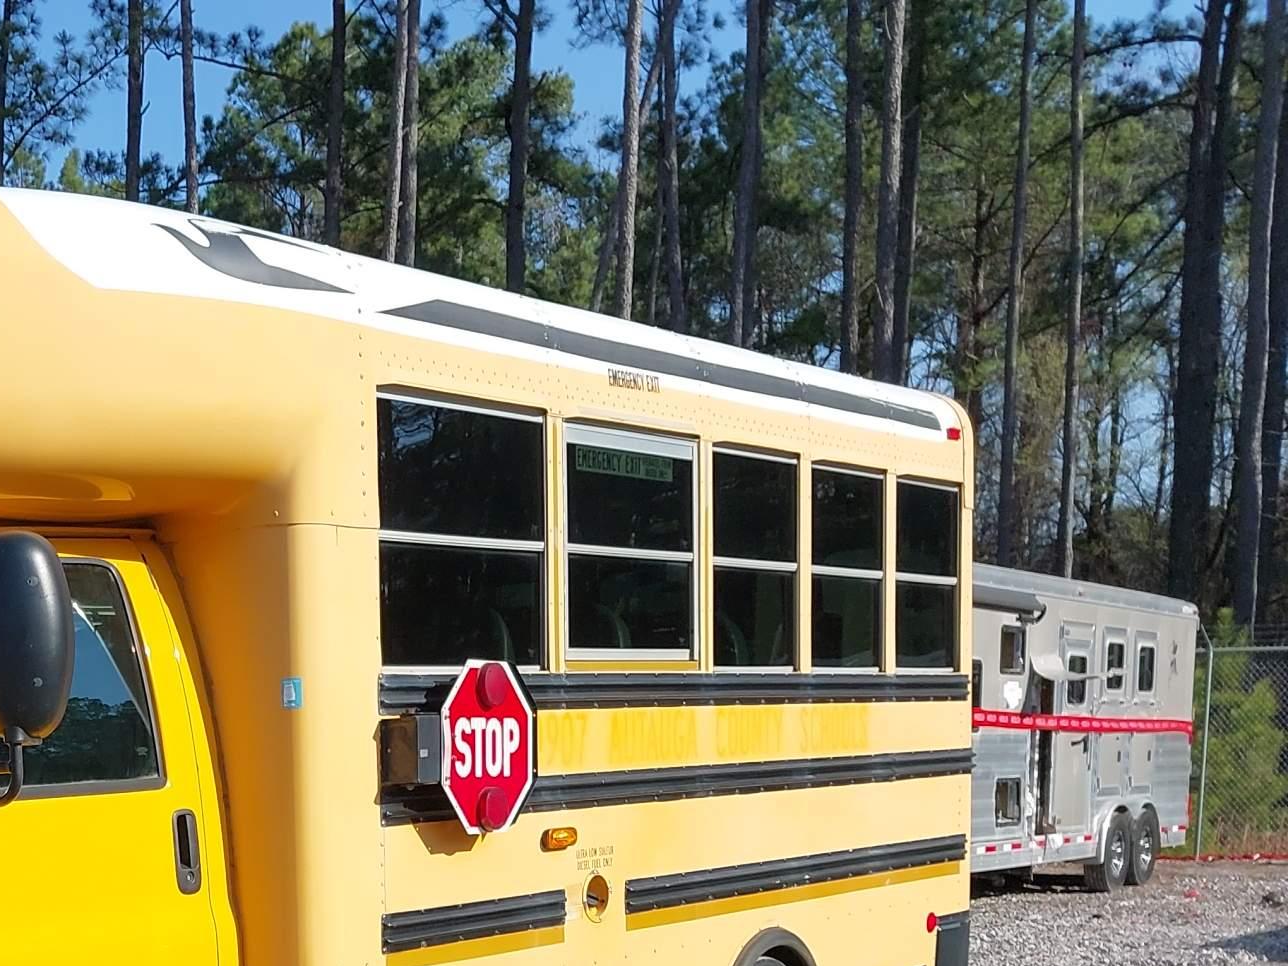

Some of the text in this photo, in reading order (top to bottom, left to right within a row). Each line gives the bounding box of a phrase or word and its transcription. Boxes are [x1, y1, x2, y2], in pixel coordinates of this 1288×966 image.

[607, 368, 661, 393] EMERGENCY EXIT
[577, 448, 622, 473] EMERGENCY
[625, 455, 641, 475] EXIT
[454, 716, 521, 779] STOP
[715, 703, 784, 758] COUNTY
